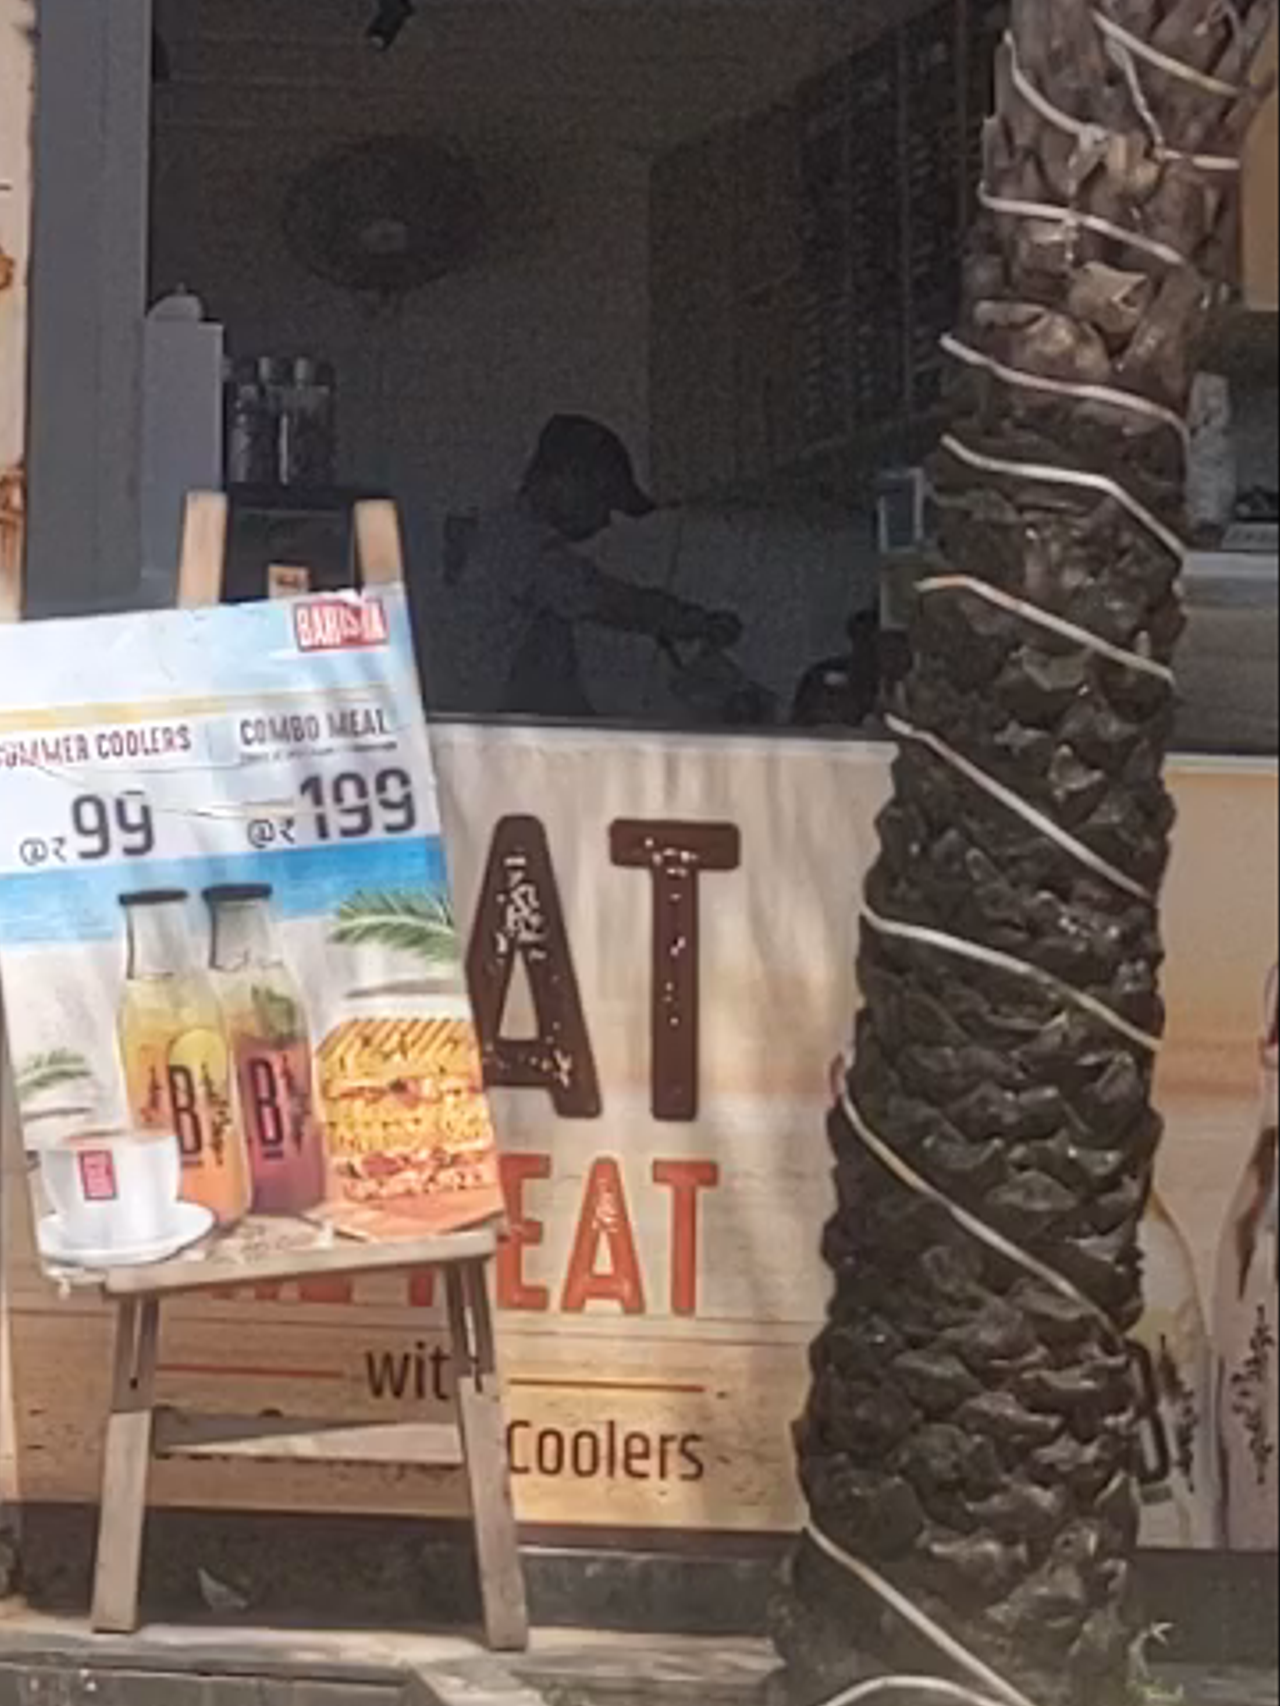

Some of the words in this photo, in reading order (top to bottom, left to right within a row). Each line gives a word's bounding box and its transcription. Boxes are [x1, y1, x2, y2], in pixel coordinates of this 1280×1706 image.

[96, 724, 192, 761] COOLERS
[240, 714, 319, 747] COMBO
[328, 707, 390, 739] MEAL
[464, 814, 741, 1122] AT
[506, 1419, 706, 1483] Coolers
